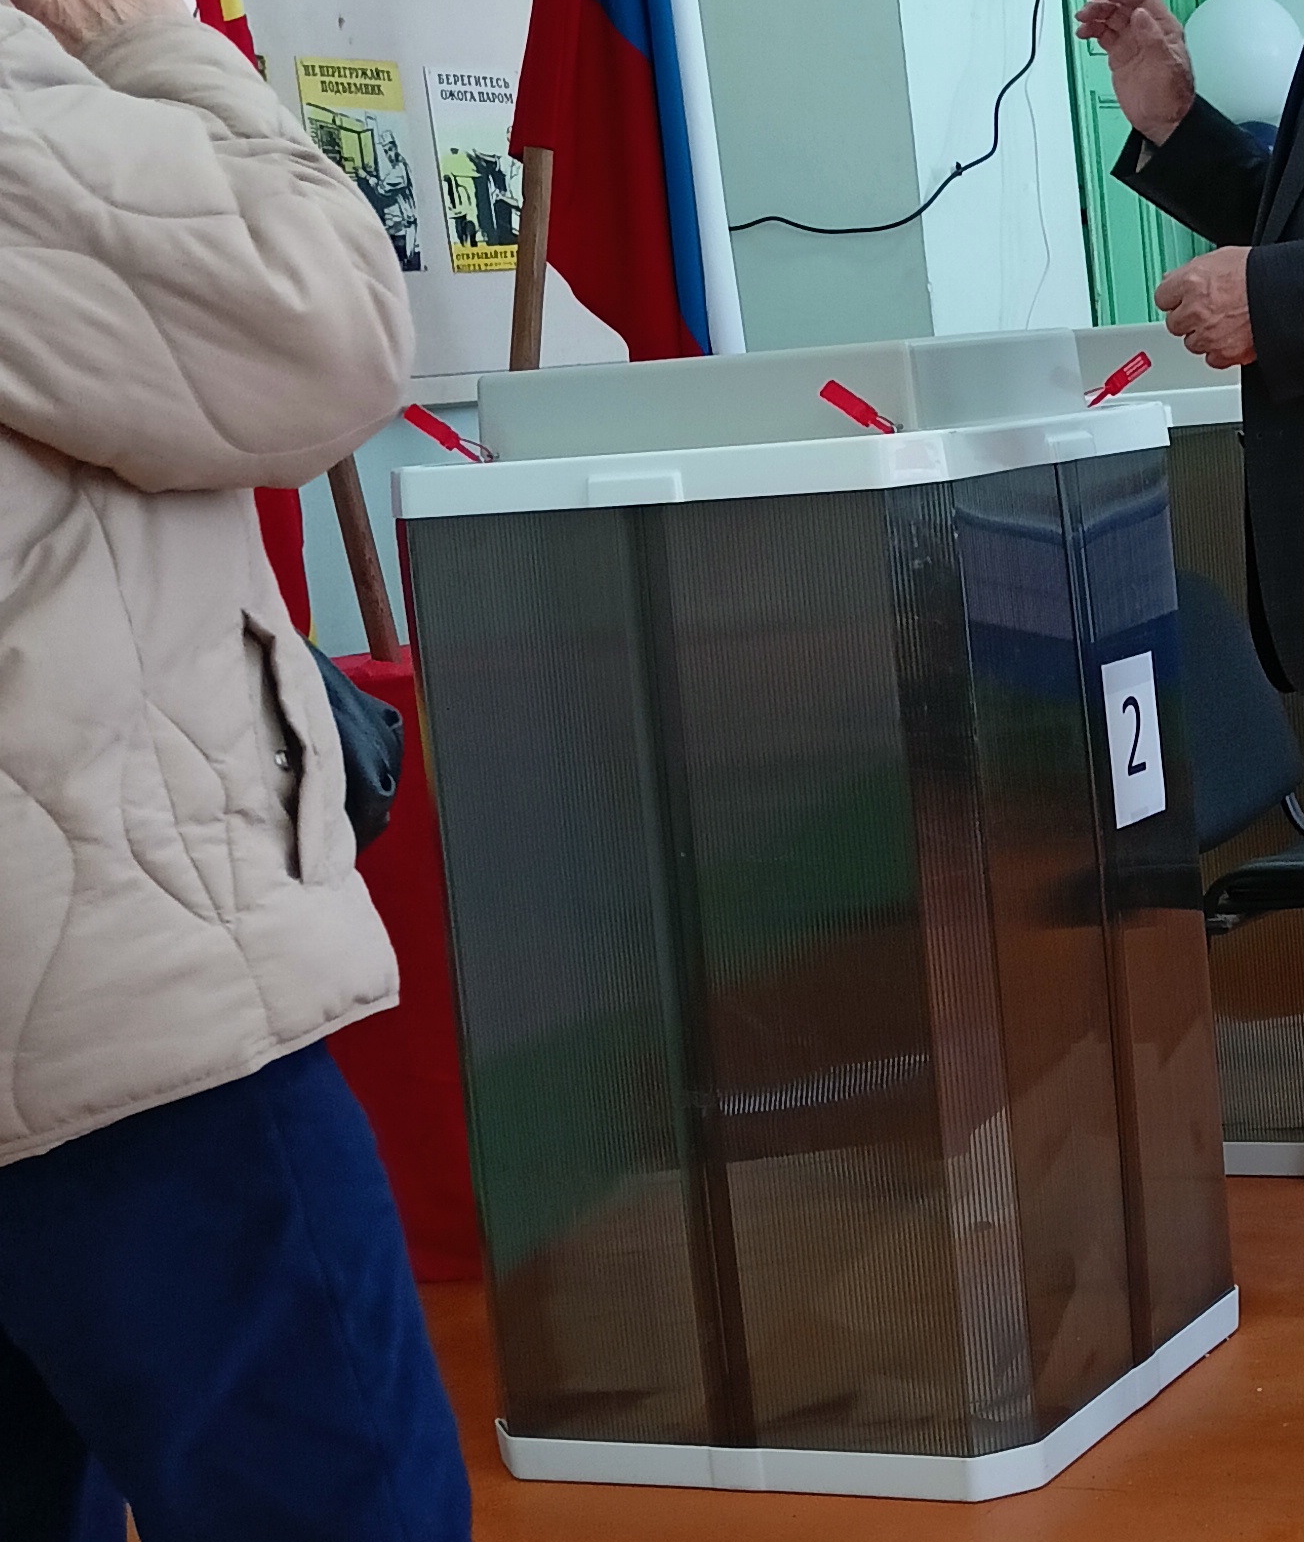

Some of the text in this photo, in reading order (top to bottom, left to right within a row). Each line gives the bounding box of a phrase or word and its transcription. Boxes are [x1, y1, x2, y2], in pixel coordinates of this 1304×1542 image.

[302, 64, 392, 82] НЕ ПЕРЕГРУЖАЙТЕ
[437, 73, 510, 89] БЕРЕГИТЕСЬ
[320, 80, 384, 96] ПОДЪЕМНИК
[440, 89, 514, 104] ОЖОГА ПАРОМ
[1122, 695, 1147, 777] 2
